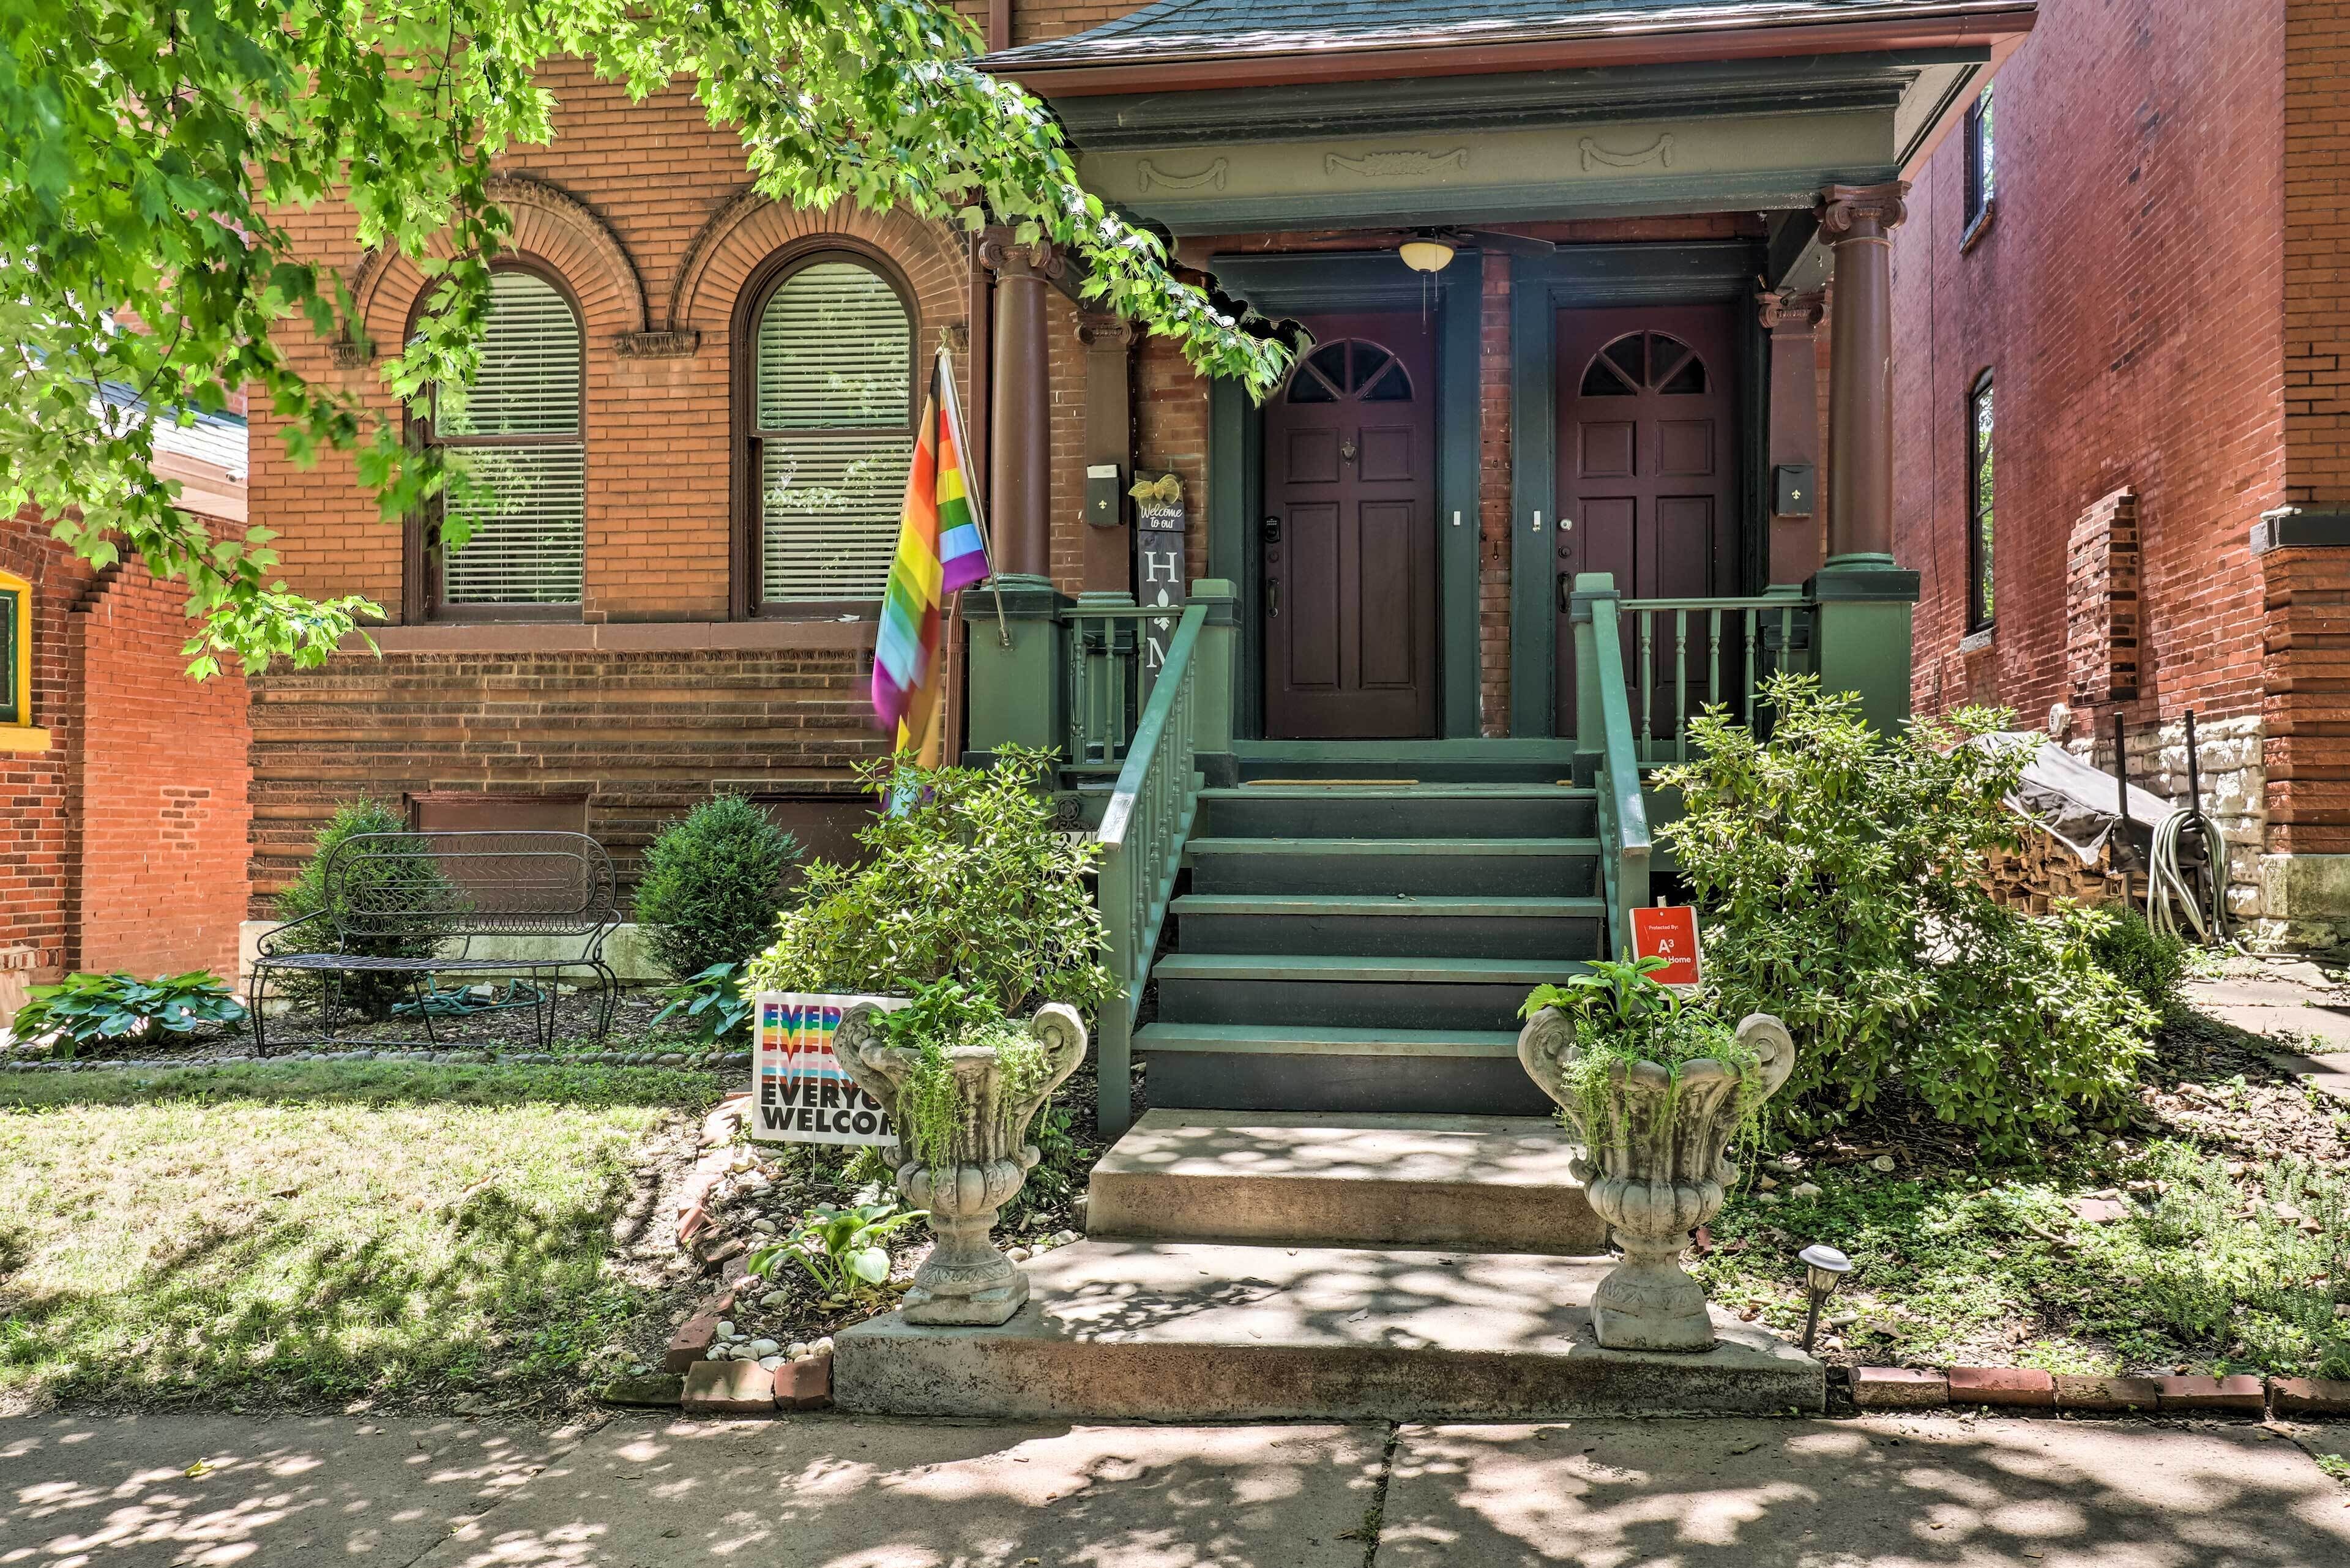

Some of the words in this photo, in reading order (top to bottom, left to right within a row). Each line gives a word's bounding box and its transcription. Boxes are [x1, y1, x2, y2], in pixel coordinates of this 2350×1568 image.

[1141, 503, 1183, 518] Welcome
[1150, 517, 1160, 528] to
[1161, 519, 1174, 528] our
[761, 1075, 882, 1111] EVERYO
